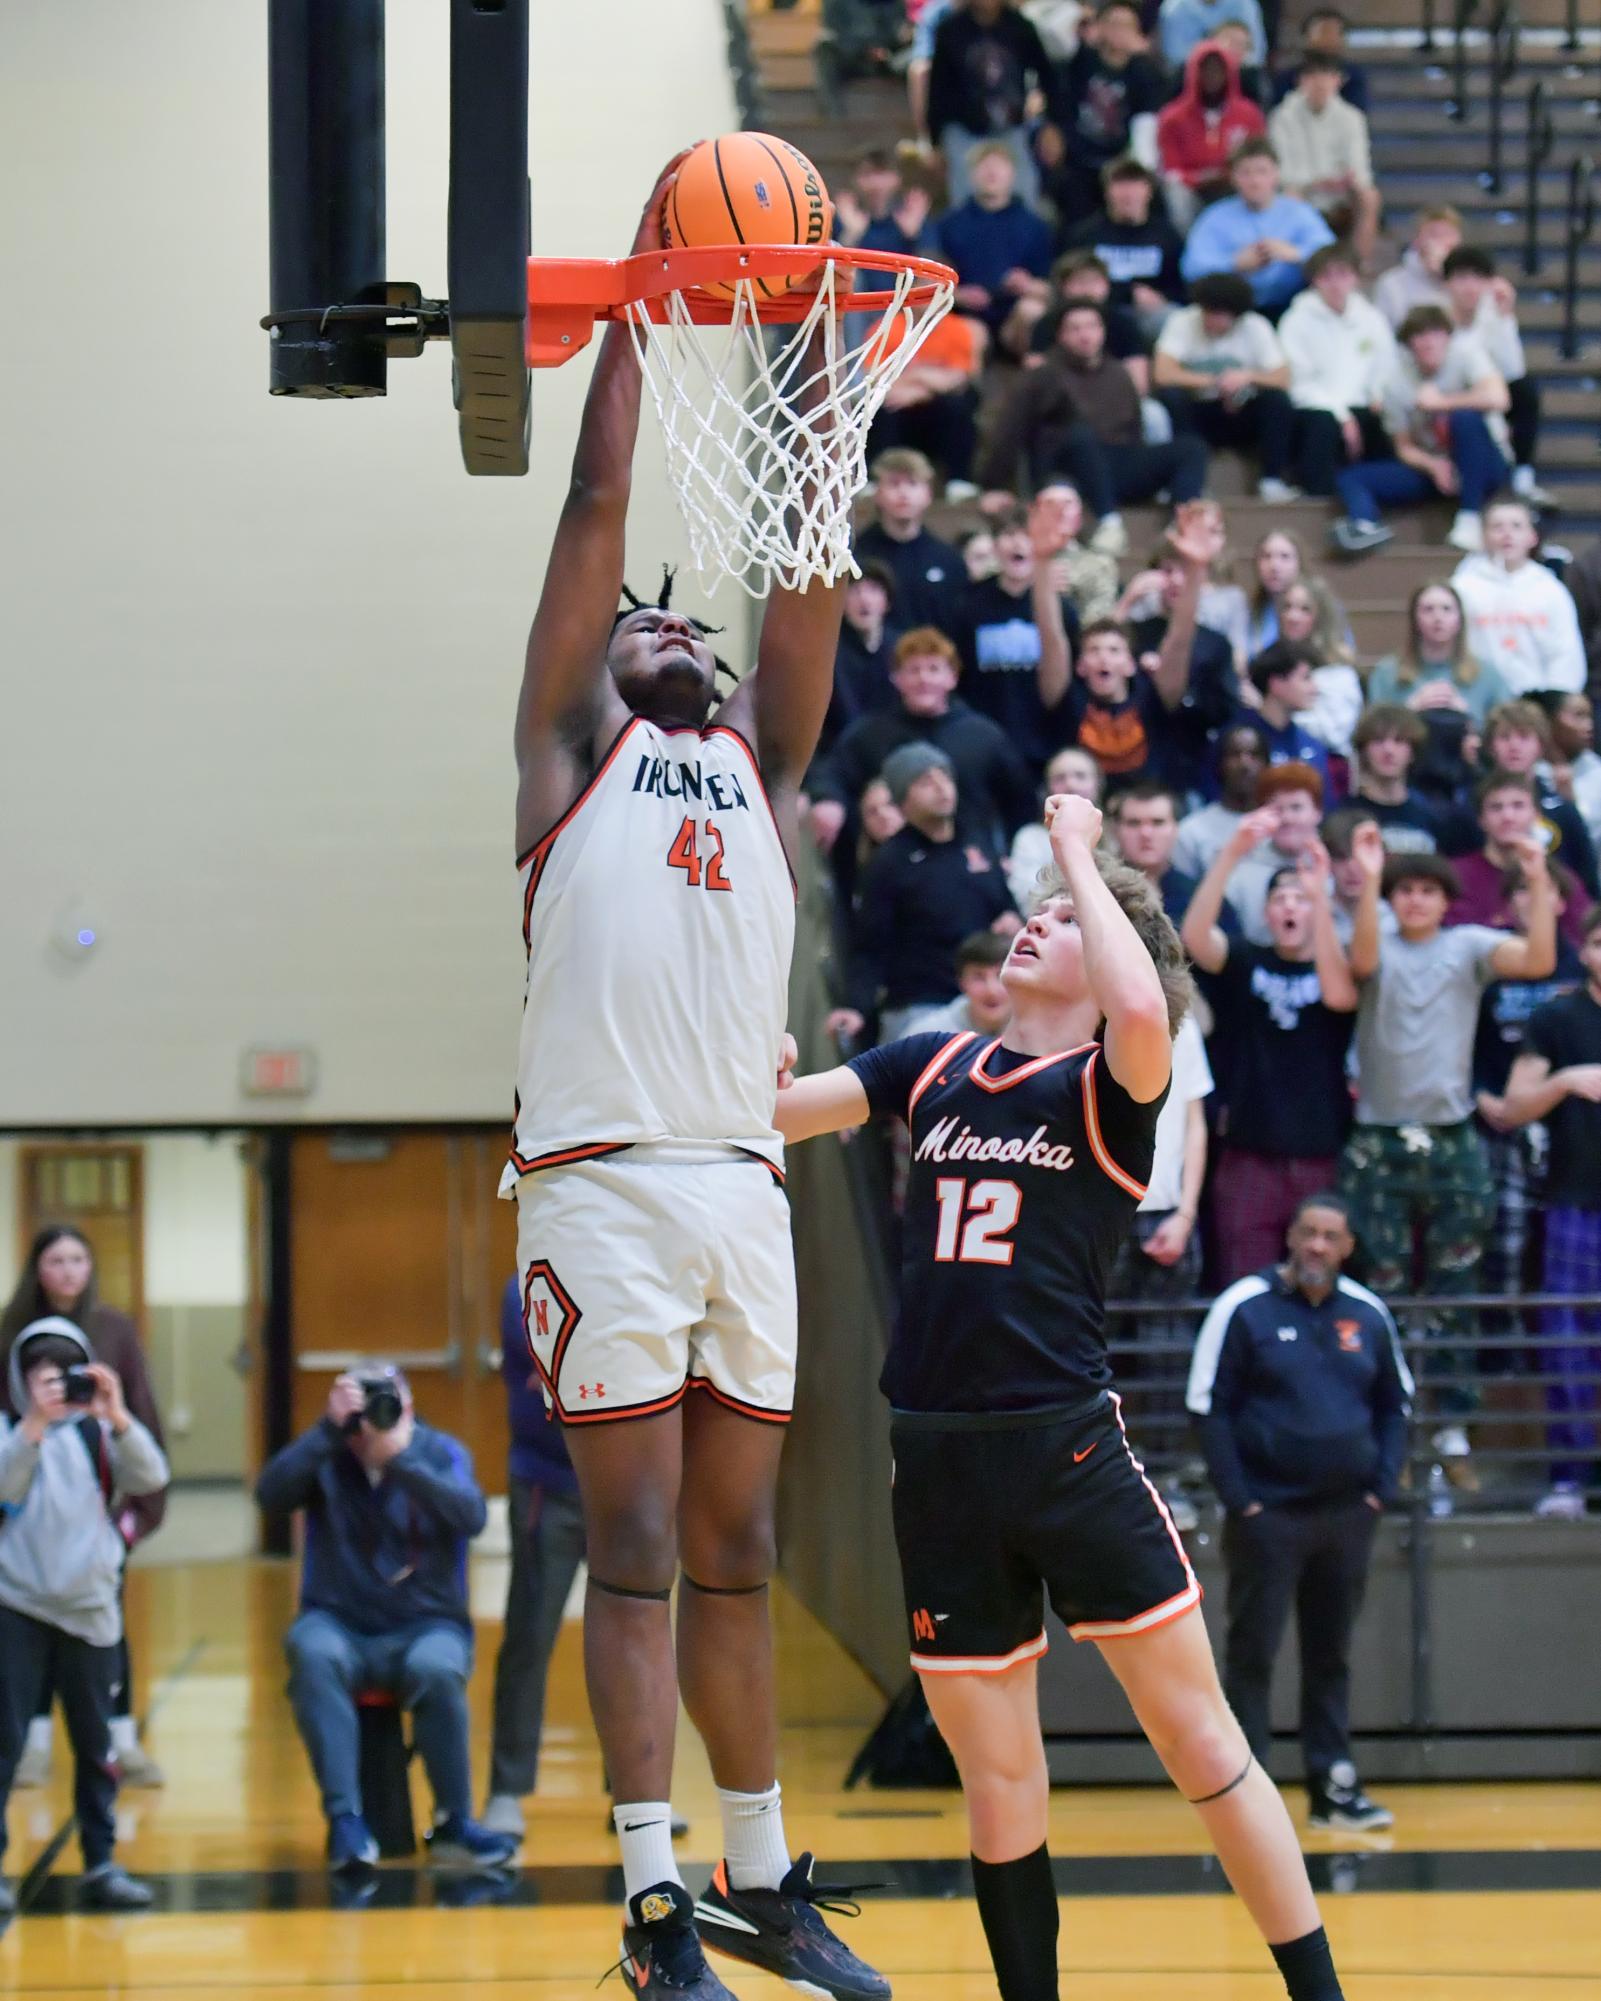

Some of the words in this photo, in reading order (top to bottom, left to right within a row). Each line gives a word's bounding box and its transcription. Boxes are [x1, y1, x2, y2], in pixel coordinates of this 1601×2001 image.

[632, 753, 750, 812] IRONEN
[667, 815, 733, 892] 42
[914, 1115, 1075, 1171] Minooka
[934, 1177, 1023, 1266] 12
[533, 1299, 549, 1336] N
[912, 1607, 935, 1642] M
